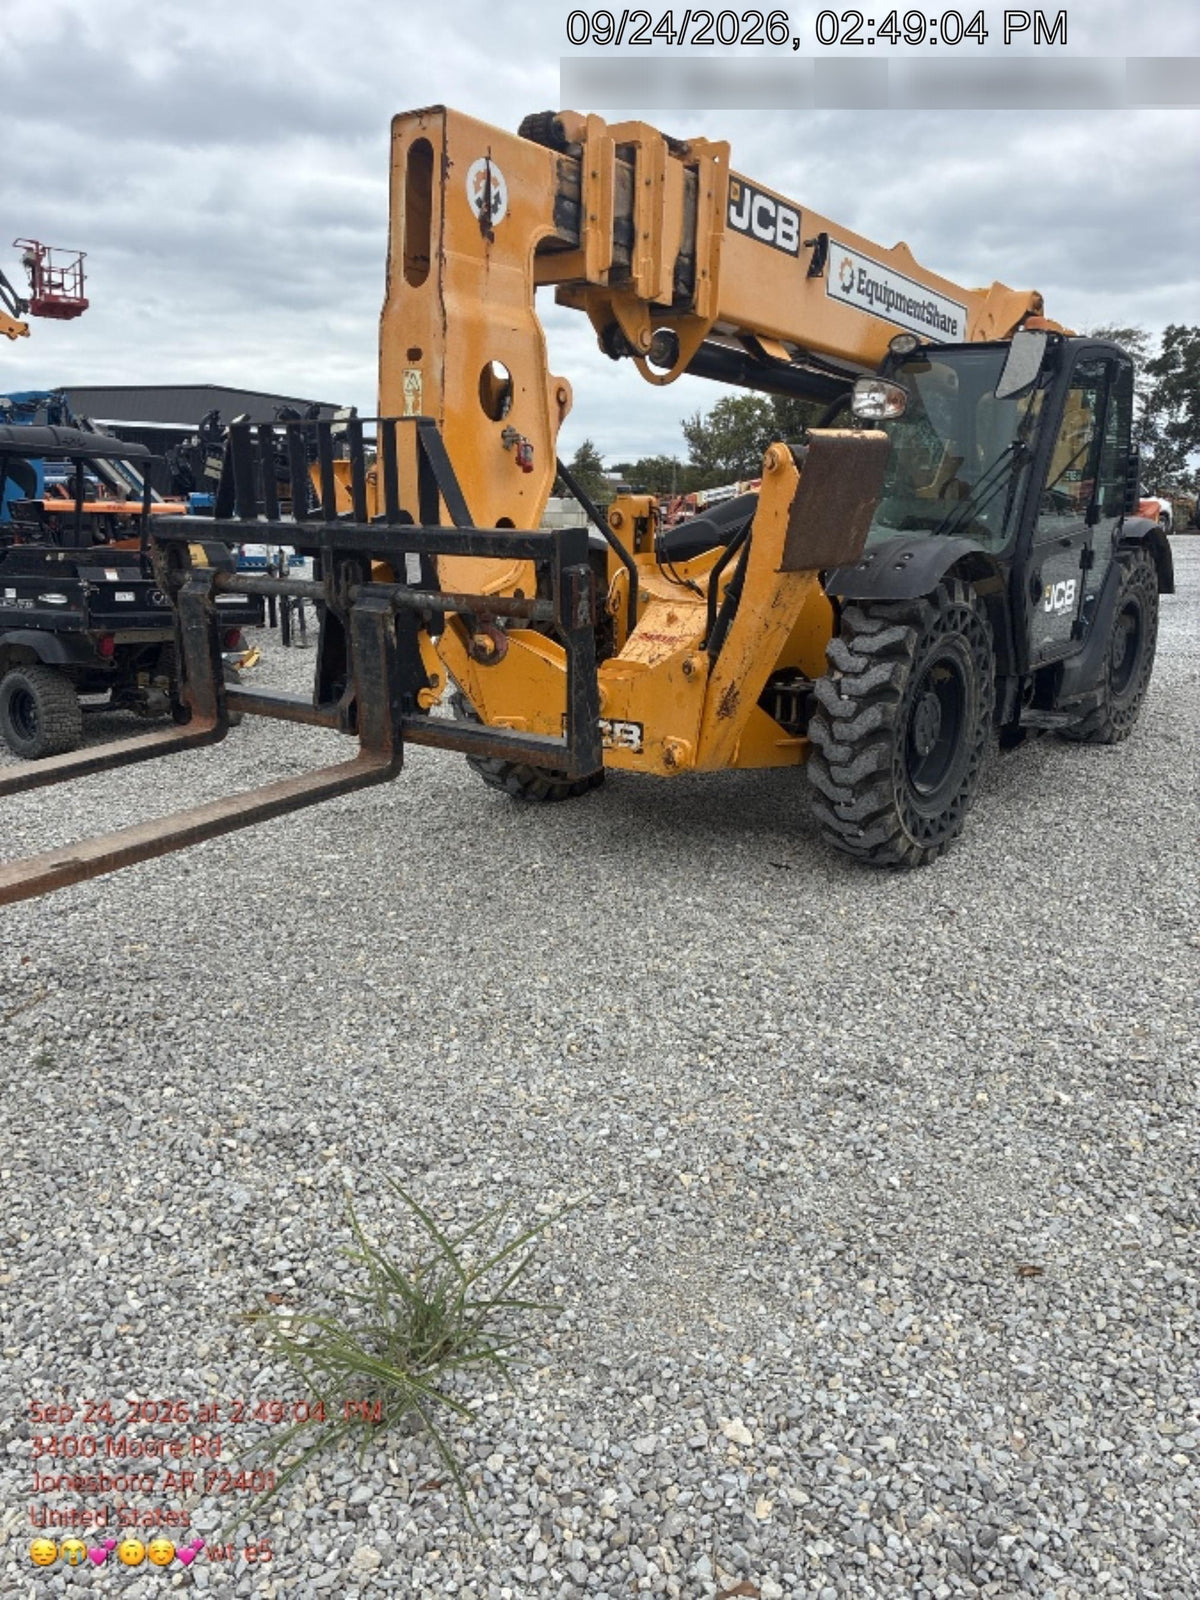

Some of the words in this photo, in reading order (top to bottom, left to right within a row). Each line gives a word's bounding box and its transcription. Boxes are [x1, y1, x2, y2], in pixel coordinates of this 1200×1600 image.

[729, 186, 799, 253] JCB
[857, 267, 958, 336] EquipmentShare
[1044, 579, 1076, 612] JCB
